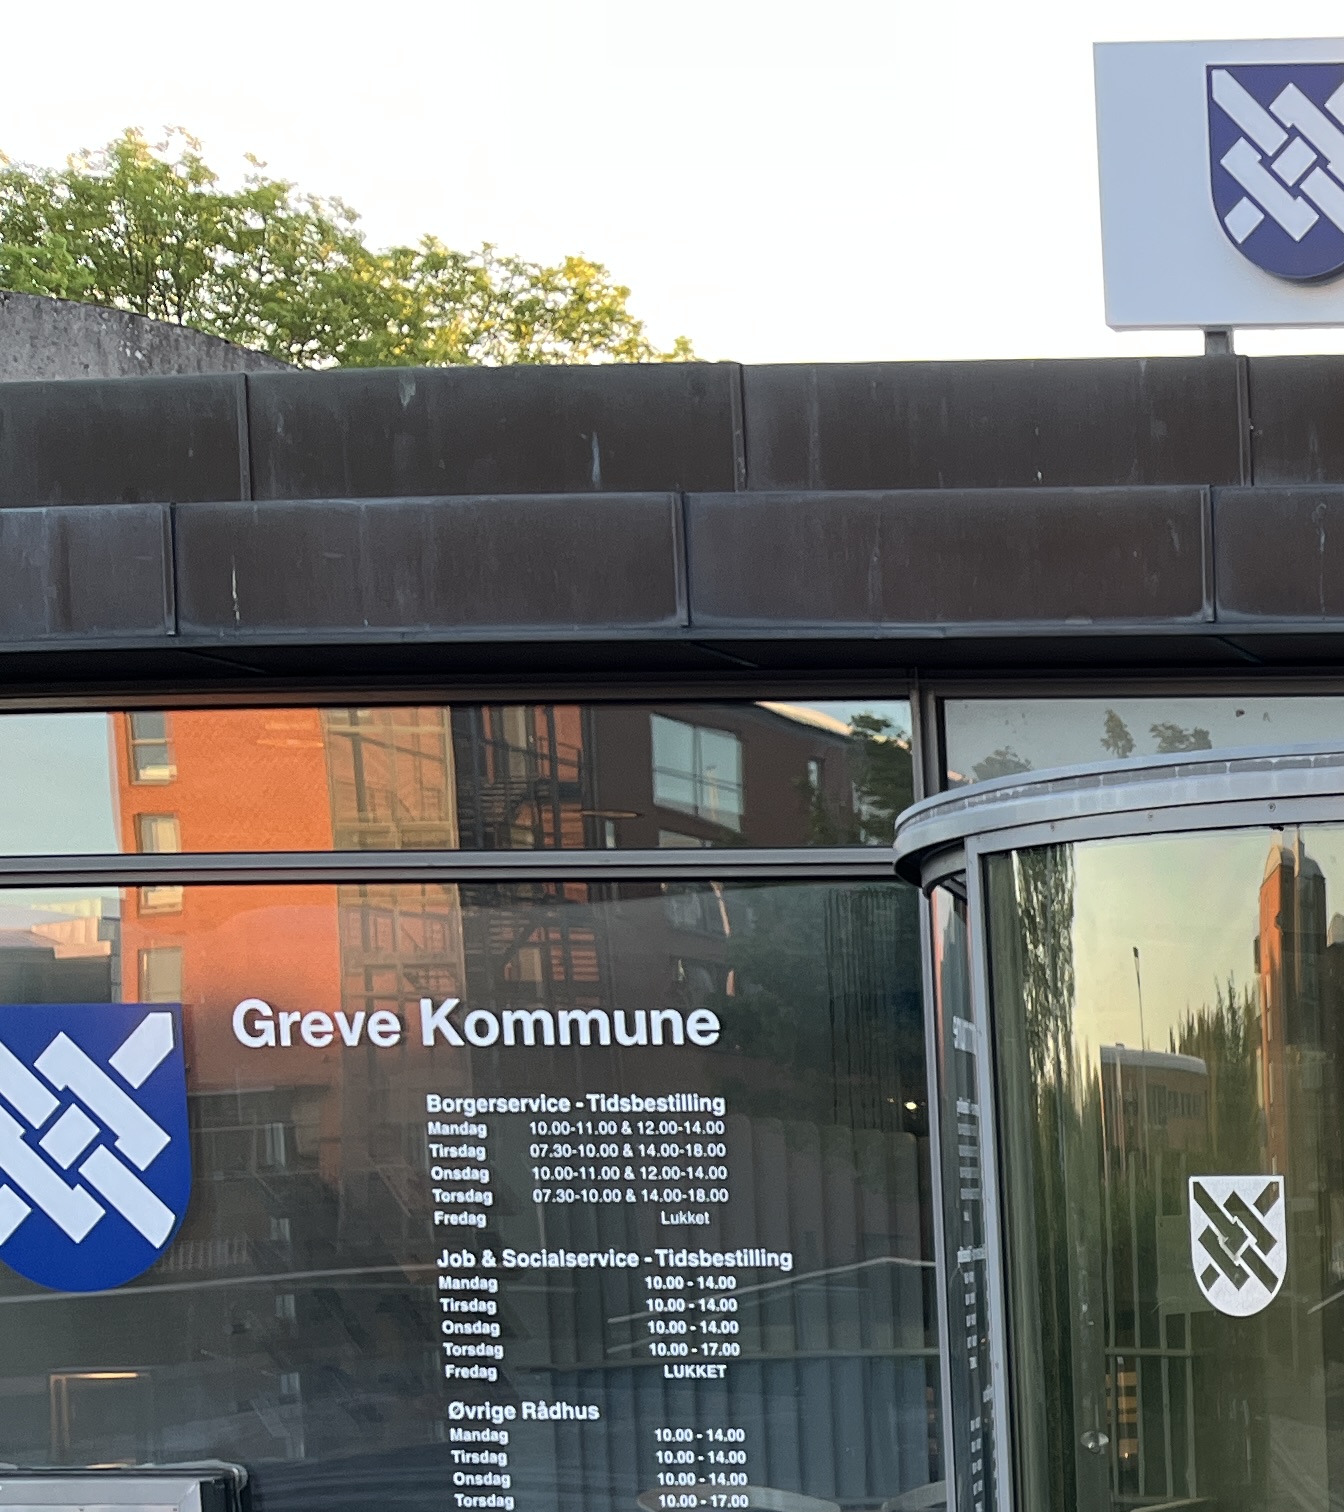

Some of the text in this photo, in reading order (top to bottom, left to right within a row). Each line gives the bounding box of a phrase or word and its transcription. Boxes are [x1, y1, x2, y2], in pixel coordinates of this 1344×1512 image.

[232, 997, 720, 1048] Greve Kommune
[426, 1094, 570, 1116] Borgerservice
[586, 1093, 726, 1116] Tidsbestilling
[428, 1121, 725, 1138] Mandag 10.00-11.00 & 12.00-14.00
[429, 1144, 726, 1161] Tirsdag 07.30-10.00 & 14.00-18.00
[431, 1167, 728, 1183] Onsdag 10.00-11.00 & 12.00-14.00
[432, 1189, 729, 1206] Torsdag 07.30-10.00 & 14.00-18.00
[434, 1211, 709, 1228] Fredag Lukket
[437, 1250, 476, 1267] Job
[482, 1250, 496, 1267] &
[502, 1249, 639, 1267] Socialservice
[655, 1249, 793, 1271] Tidsbestilling
[439, 1276, 498, 1292] Mandag
[645, 1277, 684, 1290] 10.00
[697, 1277, 736, 1290] 14.00
[440, 1299, 497, 1315] Tirsdag
[646, 1299, 685, 1312] 10.00
[698, 1299, 737, 1312] 14.00
[442, 1321, 500, 1337] Onsdag
[648, 1321, 686, 1334] 10.00
[700, 1321, 739, 1334] 14.00
[443, 1343, 503, 1359] Torsdag
[649, 1343, 688, 1356] 10.00
[701, 1343, 740, 1356] 17.00
[445, 1365, 726, 1381] Fredag LUKKET
[448, 1400, 600, 1424] Øvrige Rådhus
[450, 1428, 508, 1444] Mandag
[655, 1429, 693, 1442] 10.00
[706, 1429, 745, 1442] 14.00
[451, 1450, 507, 1466] Tirsdag
[656, 1451, 694, 1464] 10.00
[708, 1451, 746, 1464] 14.00
[453, 1472, 511, 1488] Onsdag
[657, 1473, 696, 1486] 10.00
[709, 1473, 748, 1486] 14.00
[454, 1494, 514, 1510] Torsdag
[659, 1495, 697, 1508] 10.00
[710, 1495, 749, 1508] 17.00
